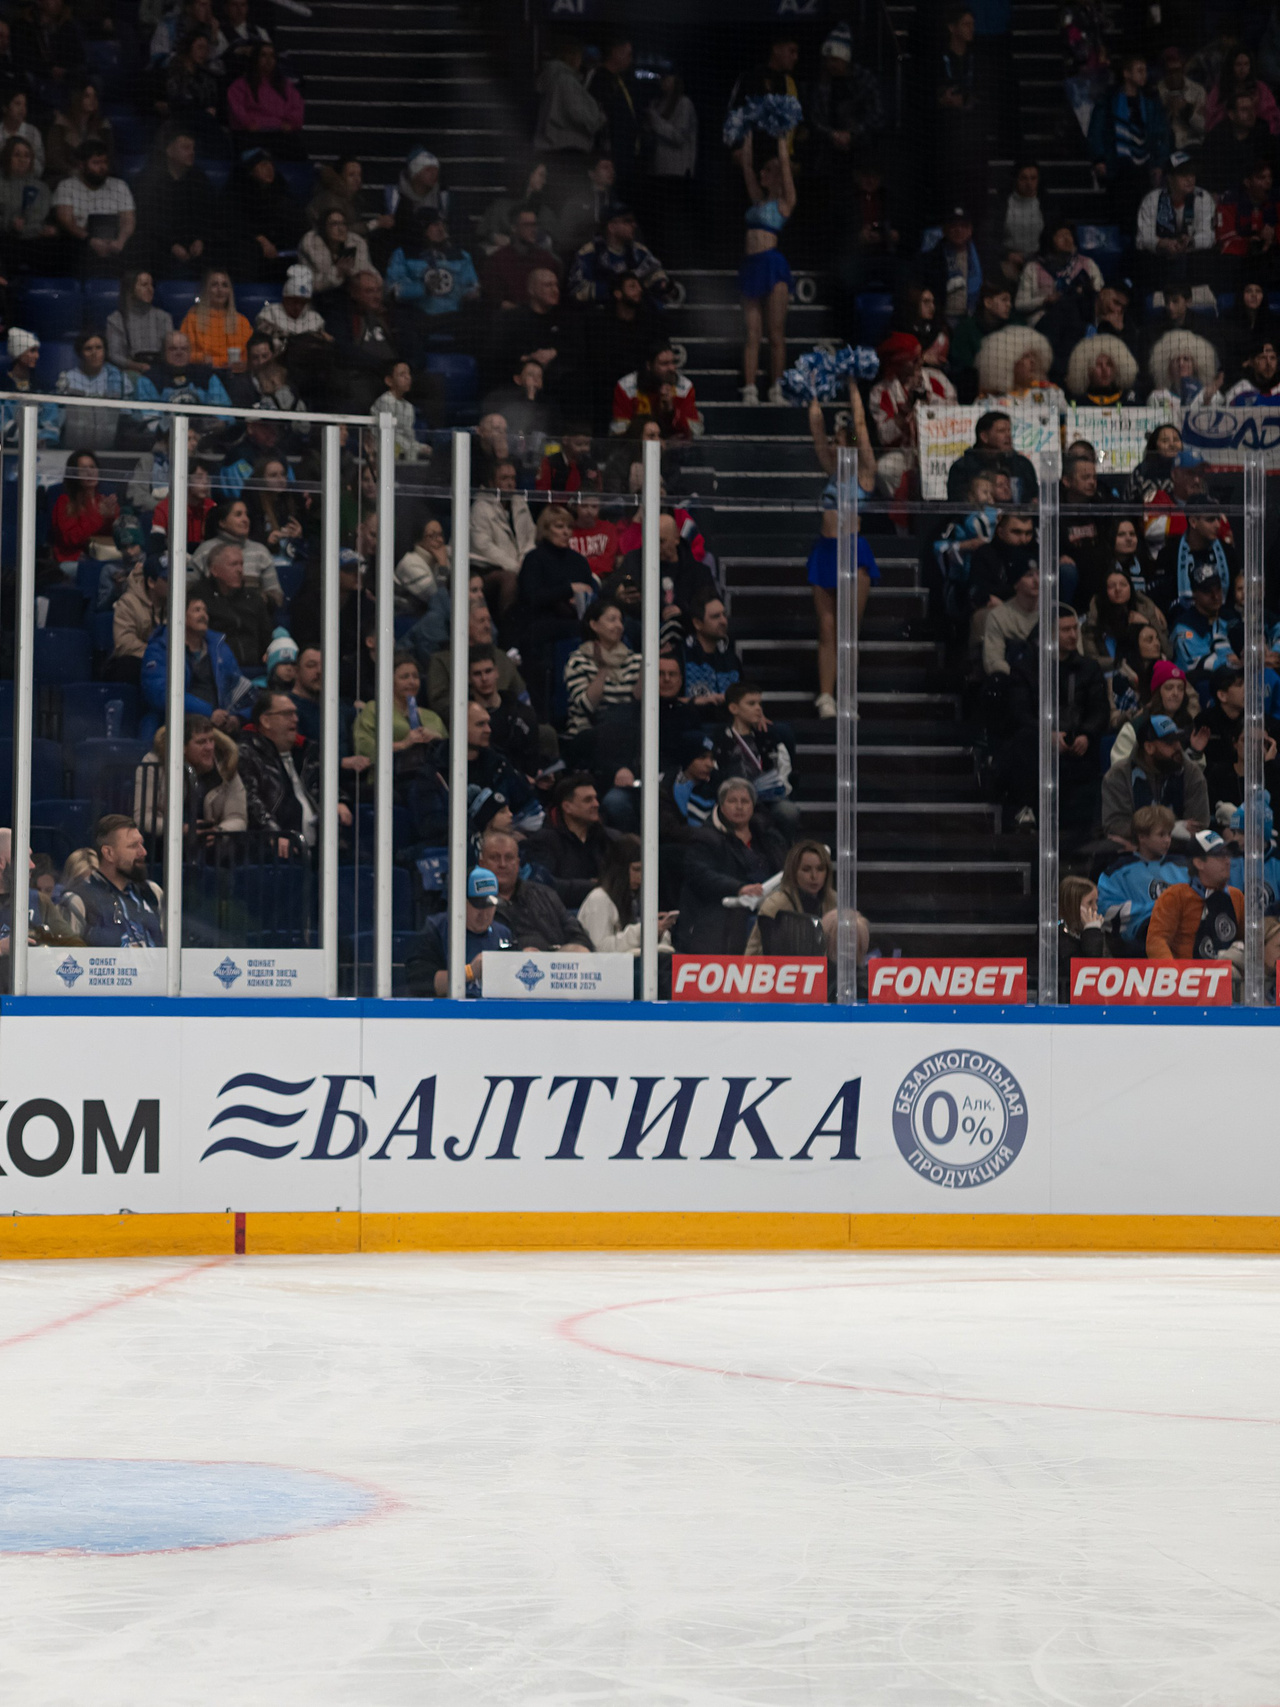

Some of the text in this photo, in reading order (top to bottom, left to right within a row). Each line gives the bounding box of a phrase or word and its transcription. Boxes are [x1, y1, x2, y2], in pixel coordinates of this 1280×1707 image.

[89, 958, 116, 966] ФОНБЕТ
[89, 968, 115, 976] НЕДЕЛЯ
[674, 962, 824, 995] FONBET
[872, 965, 1024, 996] FONBET
[1072, 967, 1229, 998] FONBET
[896, 1052, 1024, 1117] БЕЗАЛКОГОЛЬНАЯ
[301, 1074, 862, 1162] БАЛТИКА
[908, 1145, 1014, 1189] ПРОДУКЦИЯ
